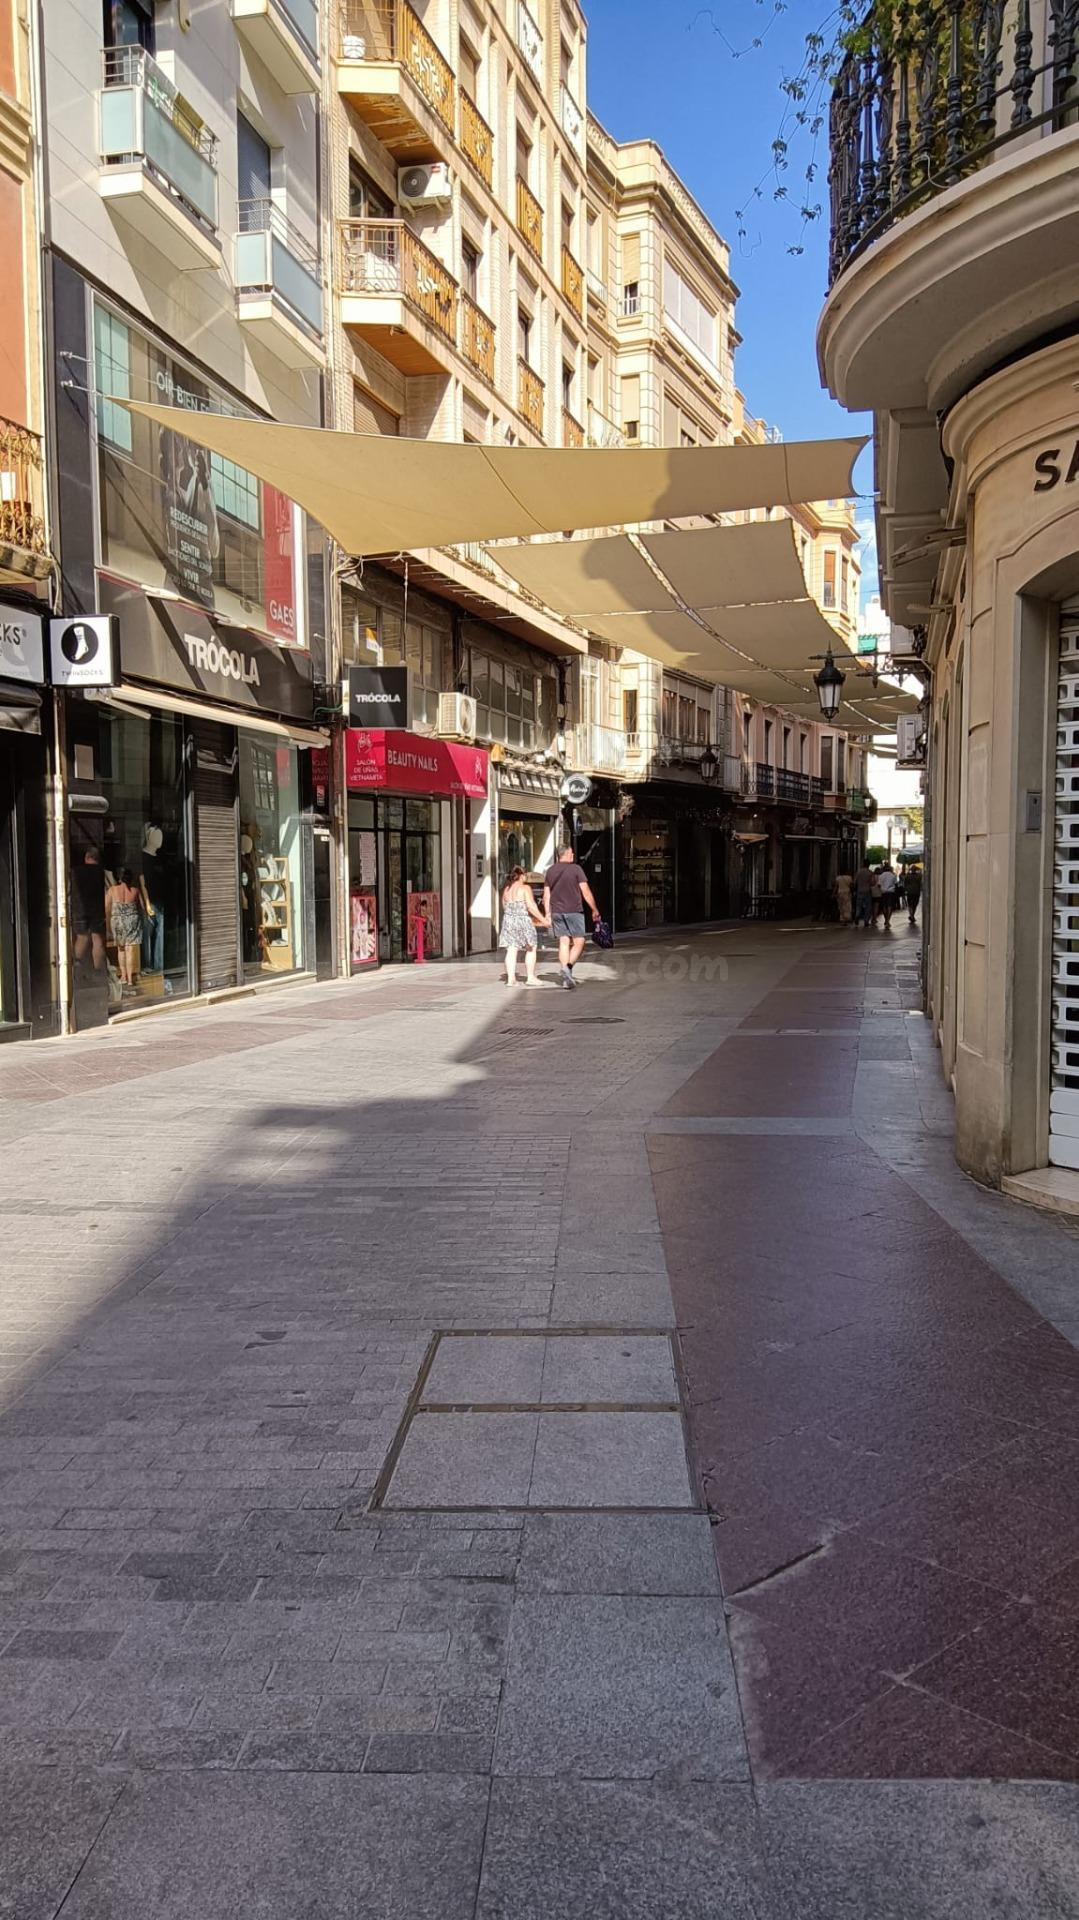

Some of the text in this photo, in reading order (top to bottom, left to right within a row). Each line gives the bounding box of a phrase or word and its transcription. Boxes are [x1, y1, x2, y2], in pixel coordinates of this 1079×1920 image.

[269, 599, 295, 628] GAES
[184, 633, 260, 687] TRÓCOLA
[355, 692, 401, 703] TRÓCOLA
[387, 749, 438, 772] BEAUTY NAILS
